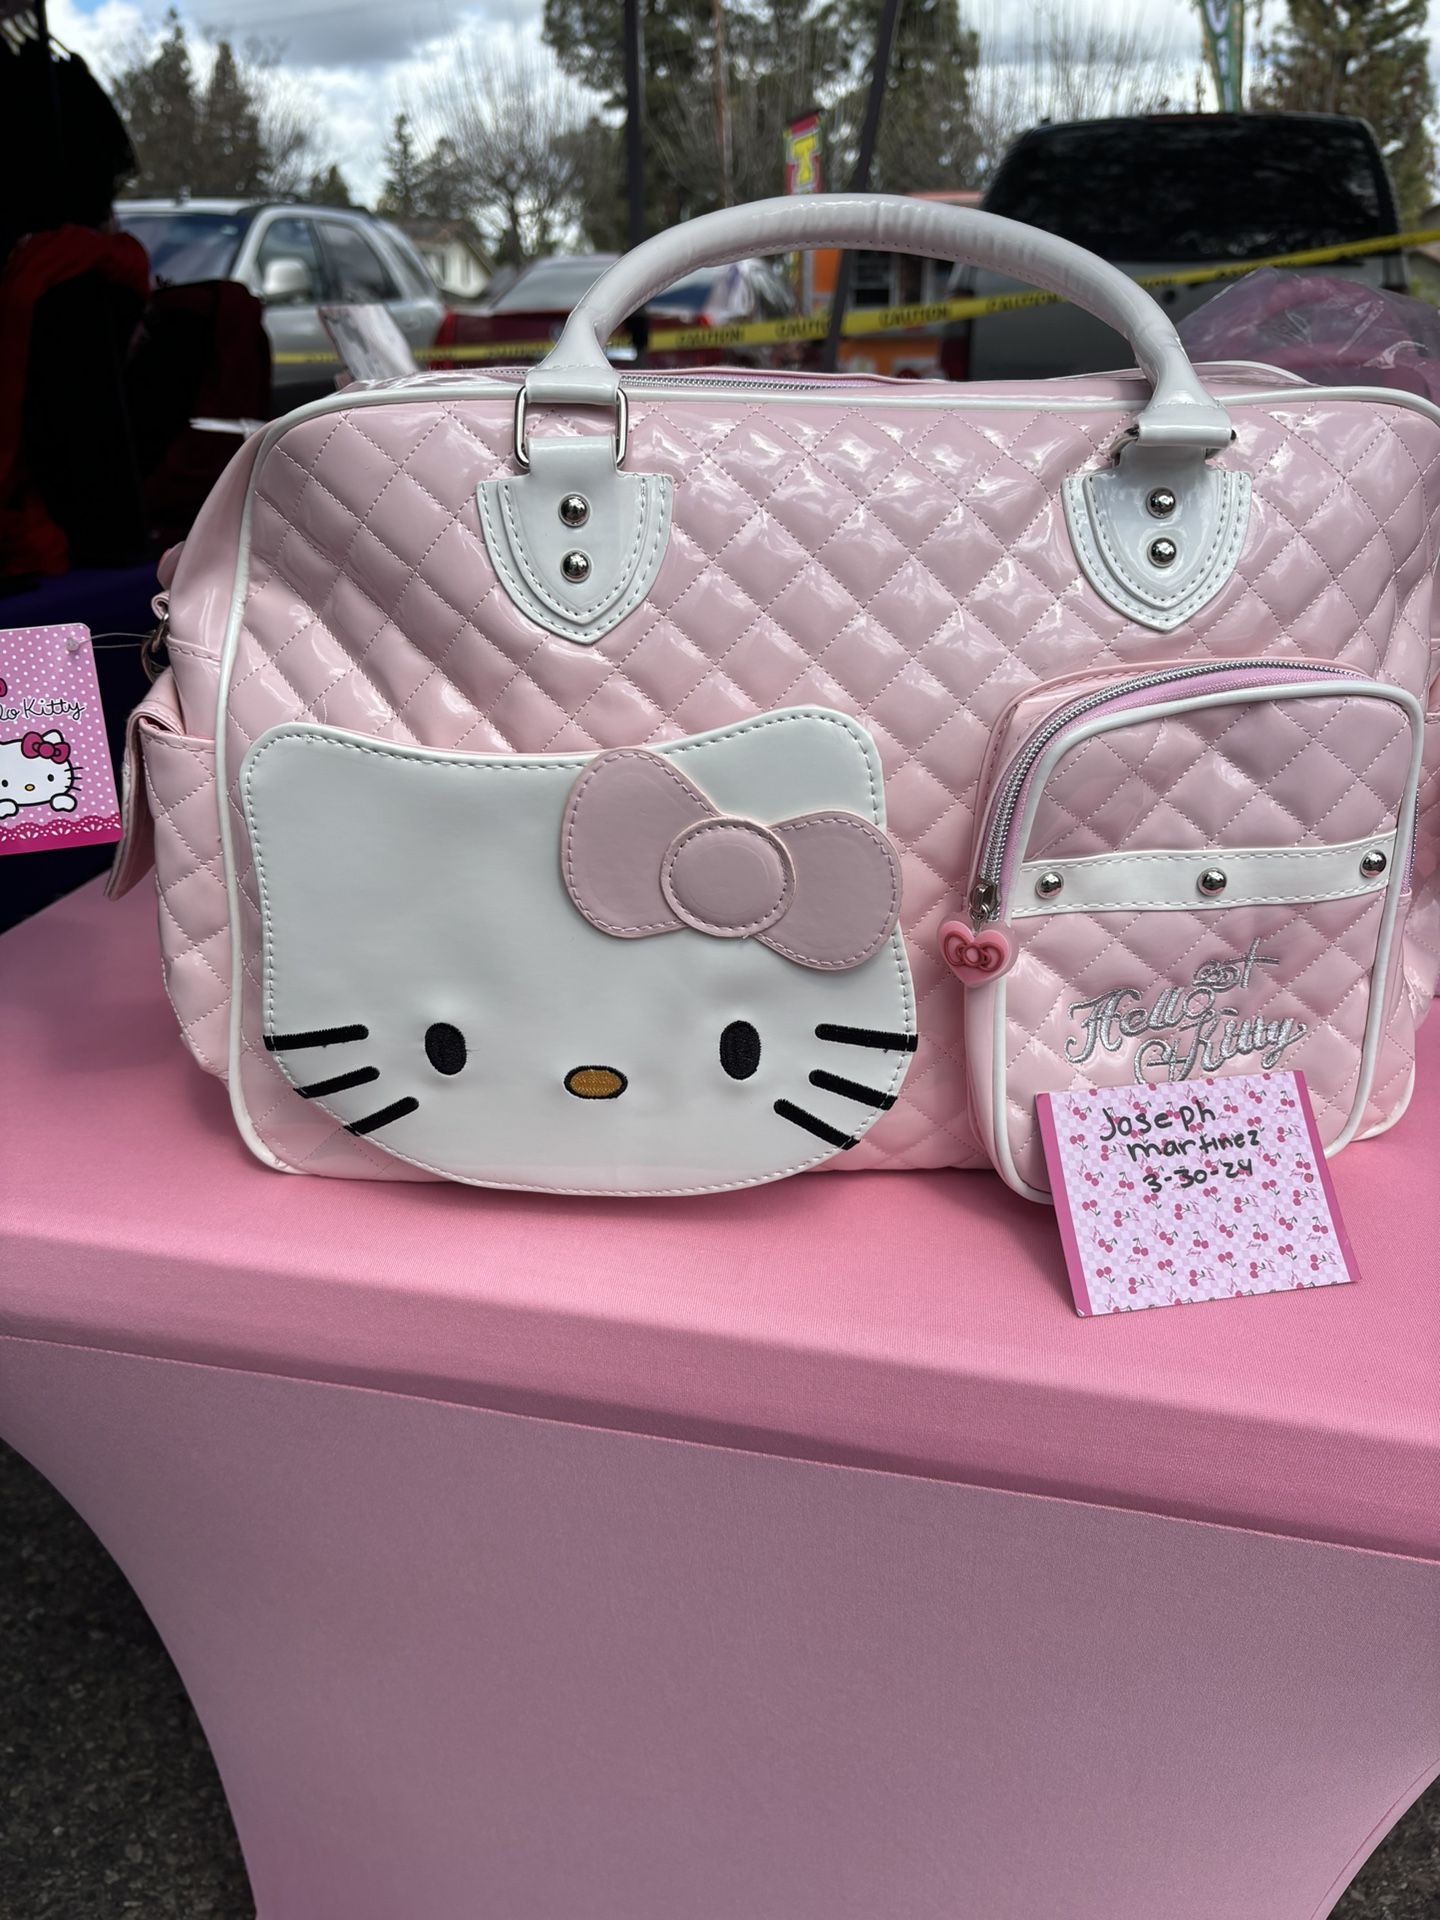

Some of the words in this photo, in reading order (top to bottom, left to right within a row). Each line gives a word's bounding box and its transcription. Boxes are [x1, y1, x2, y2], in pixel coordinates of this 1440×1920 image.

[880, 305, 948, 328] CAUTION
[23, 698, 84, 720] Kitty
[1065, 987, 1215, 1064] Hello
[1134, 1007, 1307, 1084] Kitty
[1100, 1098, 1217, 1142] Joseph
[1143, 1158, 1253, 1193] 3-30-24
